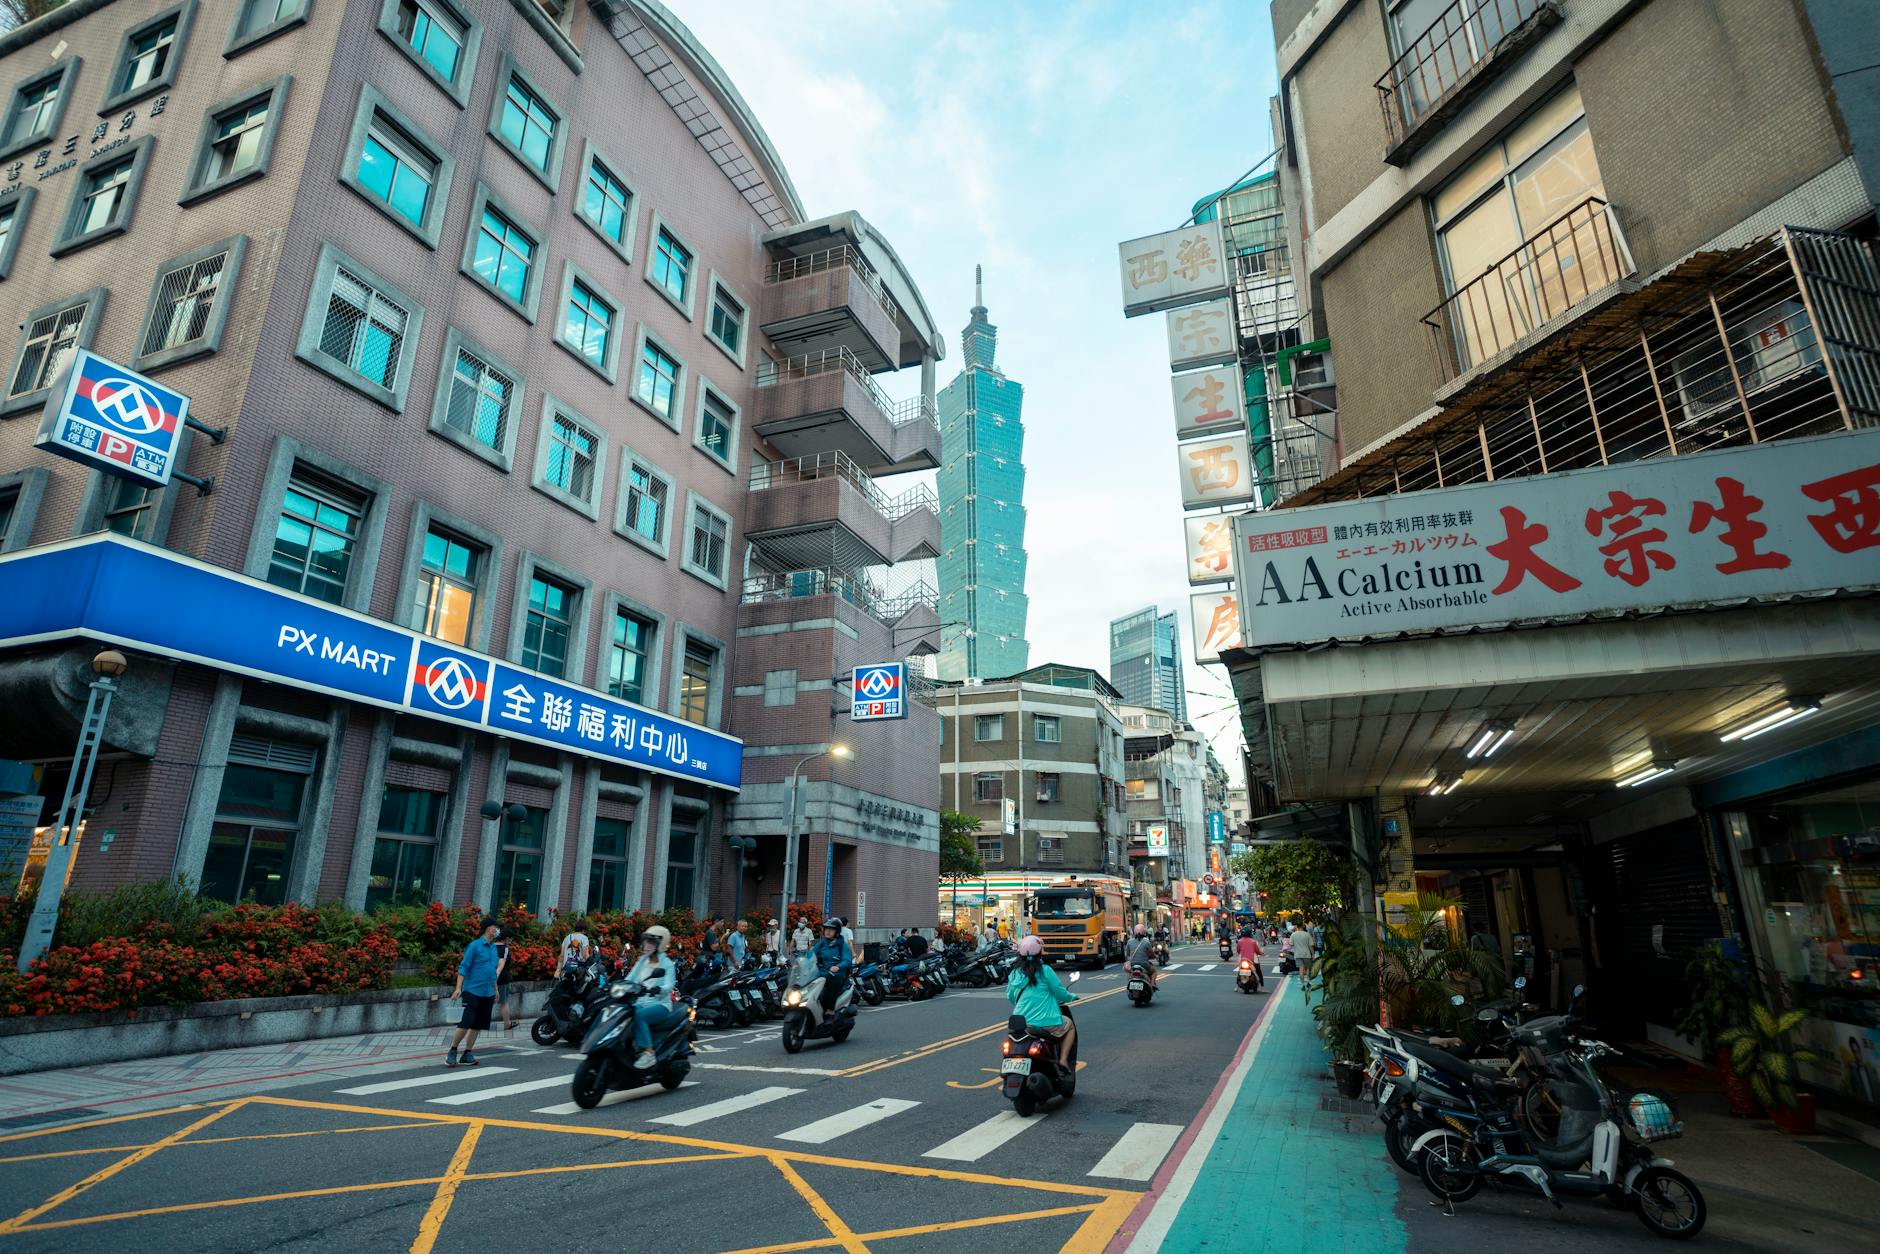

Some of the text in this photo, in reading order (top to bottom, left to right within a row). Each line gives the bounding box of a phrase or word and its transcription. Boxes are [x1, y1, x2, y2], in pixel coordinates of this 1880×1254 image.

[1126, 235, 1217, 290] 西藥
[67, 432, 93, 449] 停車
[104, 436, 128, 456] P
[136, 449, 165, 465] ATM
[1251, 528, 1327, 551] 活性吸收型
[1338, 560, 1485, 598] Calcium
[1340, 590, 1489, 618] Active Absorbable
[278, 625, 396, 676] PX MART
[871, 703, 882, 715] P
[501, 684, 687, 764] 全聯福利中心
